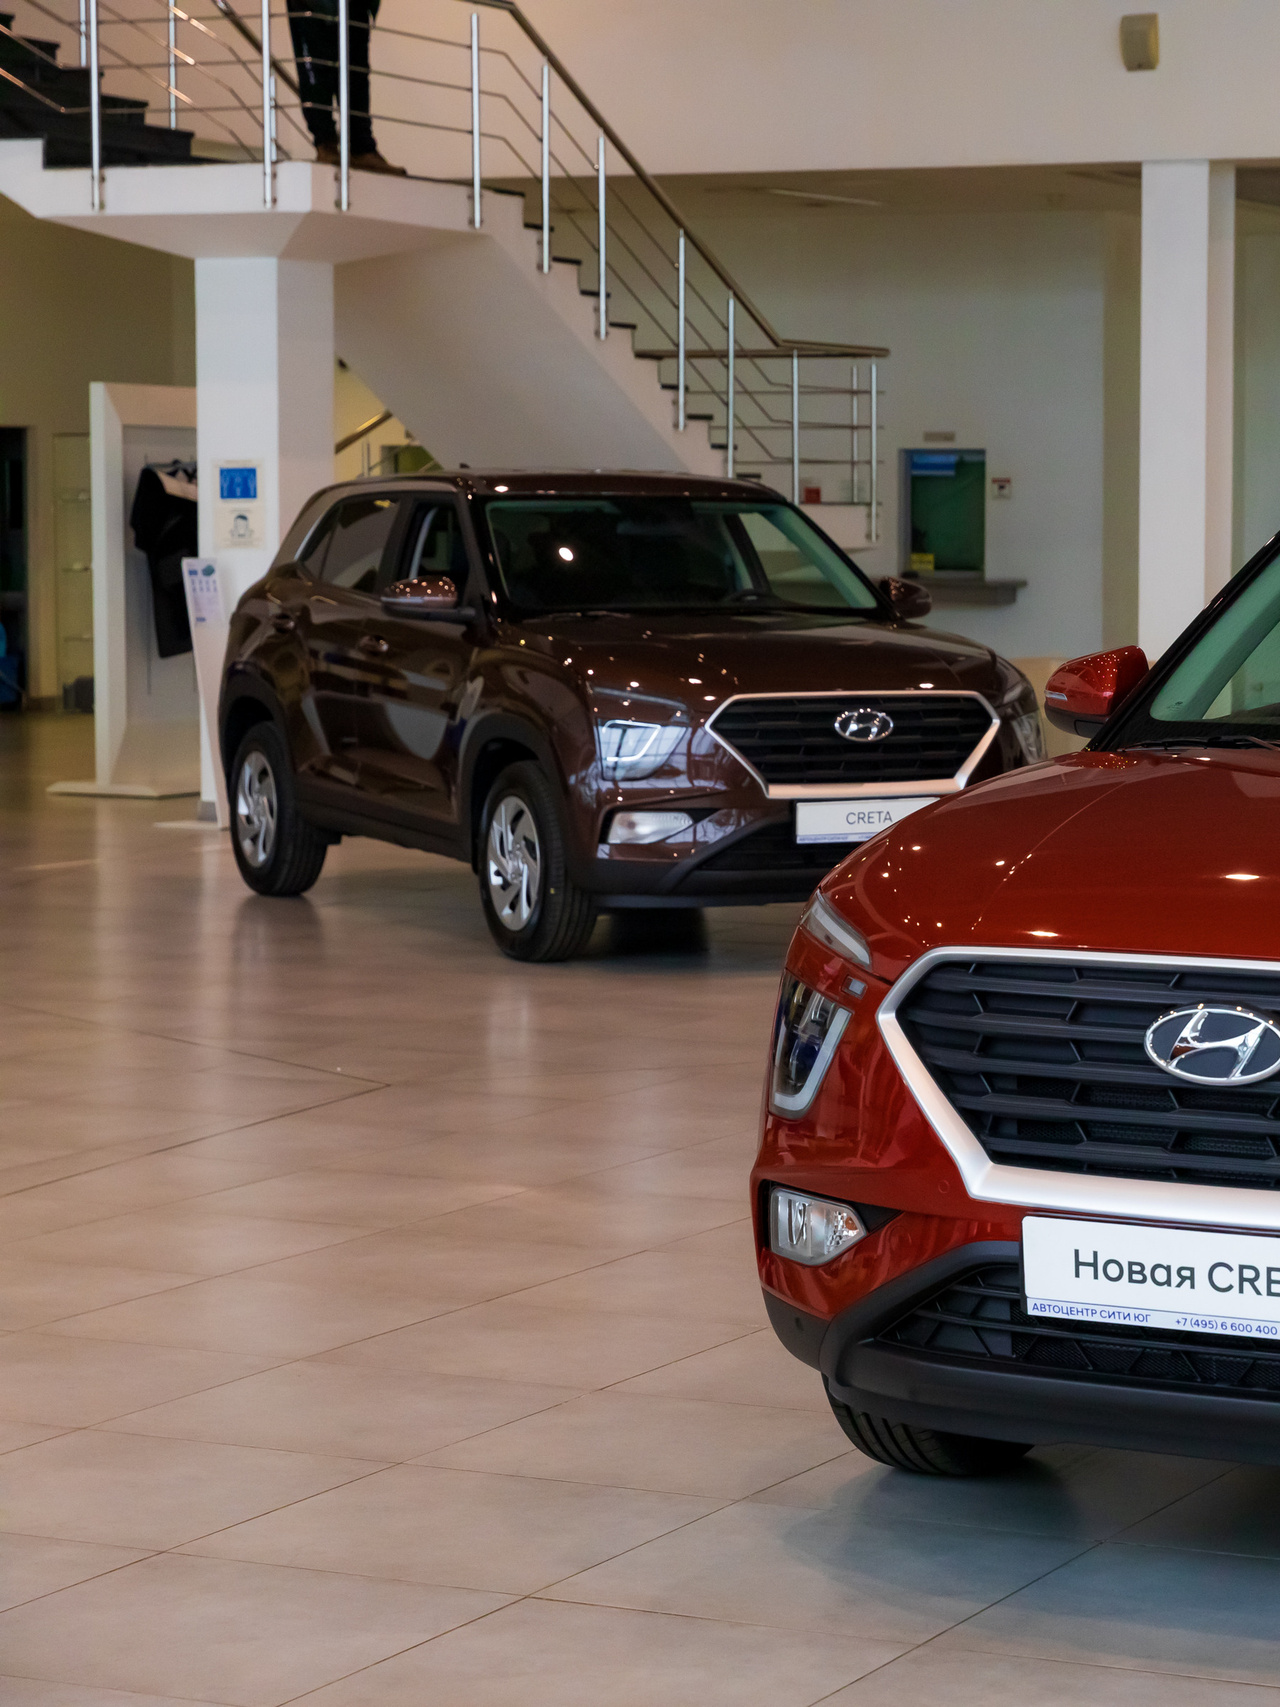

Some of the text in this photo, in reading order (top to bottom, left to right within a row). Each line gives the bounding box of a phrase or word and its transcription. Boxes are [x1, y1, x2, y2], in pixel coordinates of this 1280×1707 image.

[846, 810, 893, 825] CRETA
[1073, 1248, 1197, 1290] Новая
[1032, 1302, 1151, 1323] АВТОЦЕНТР СИТИ ЮГ
[1175, 1317, 1278, 1336] +7 (495) 6 600 400
